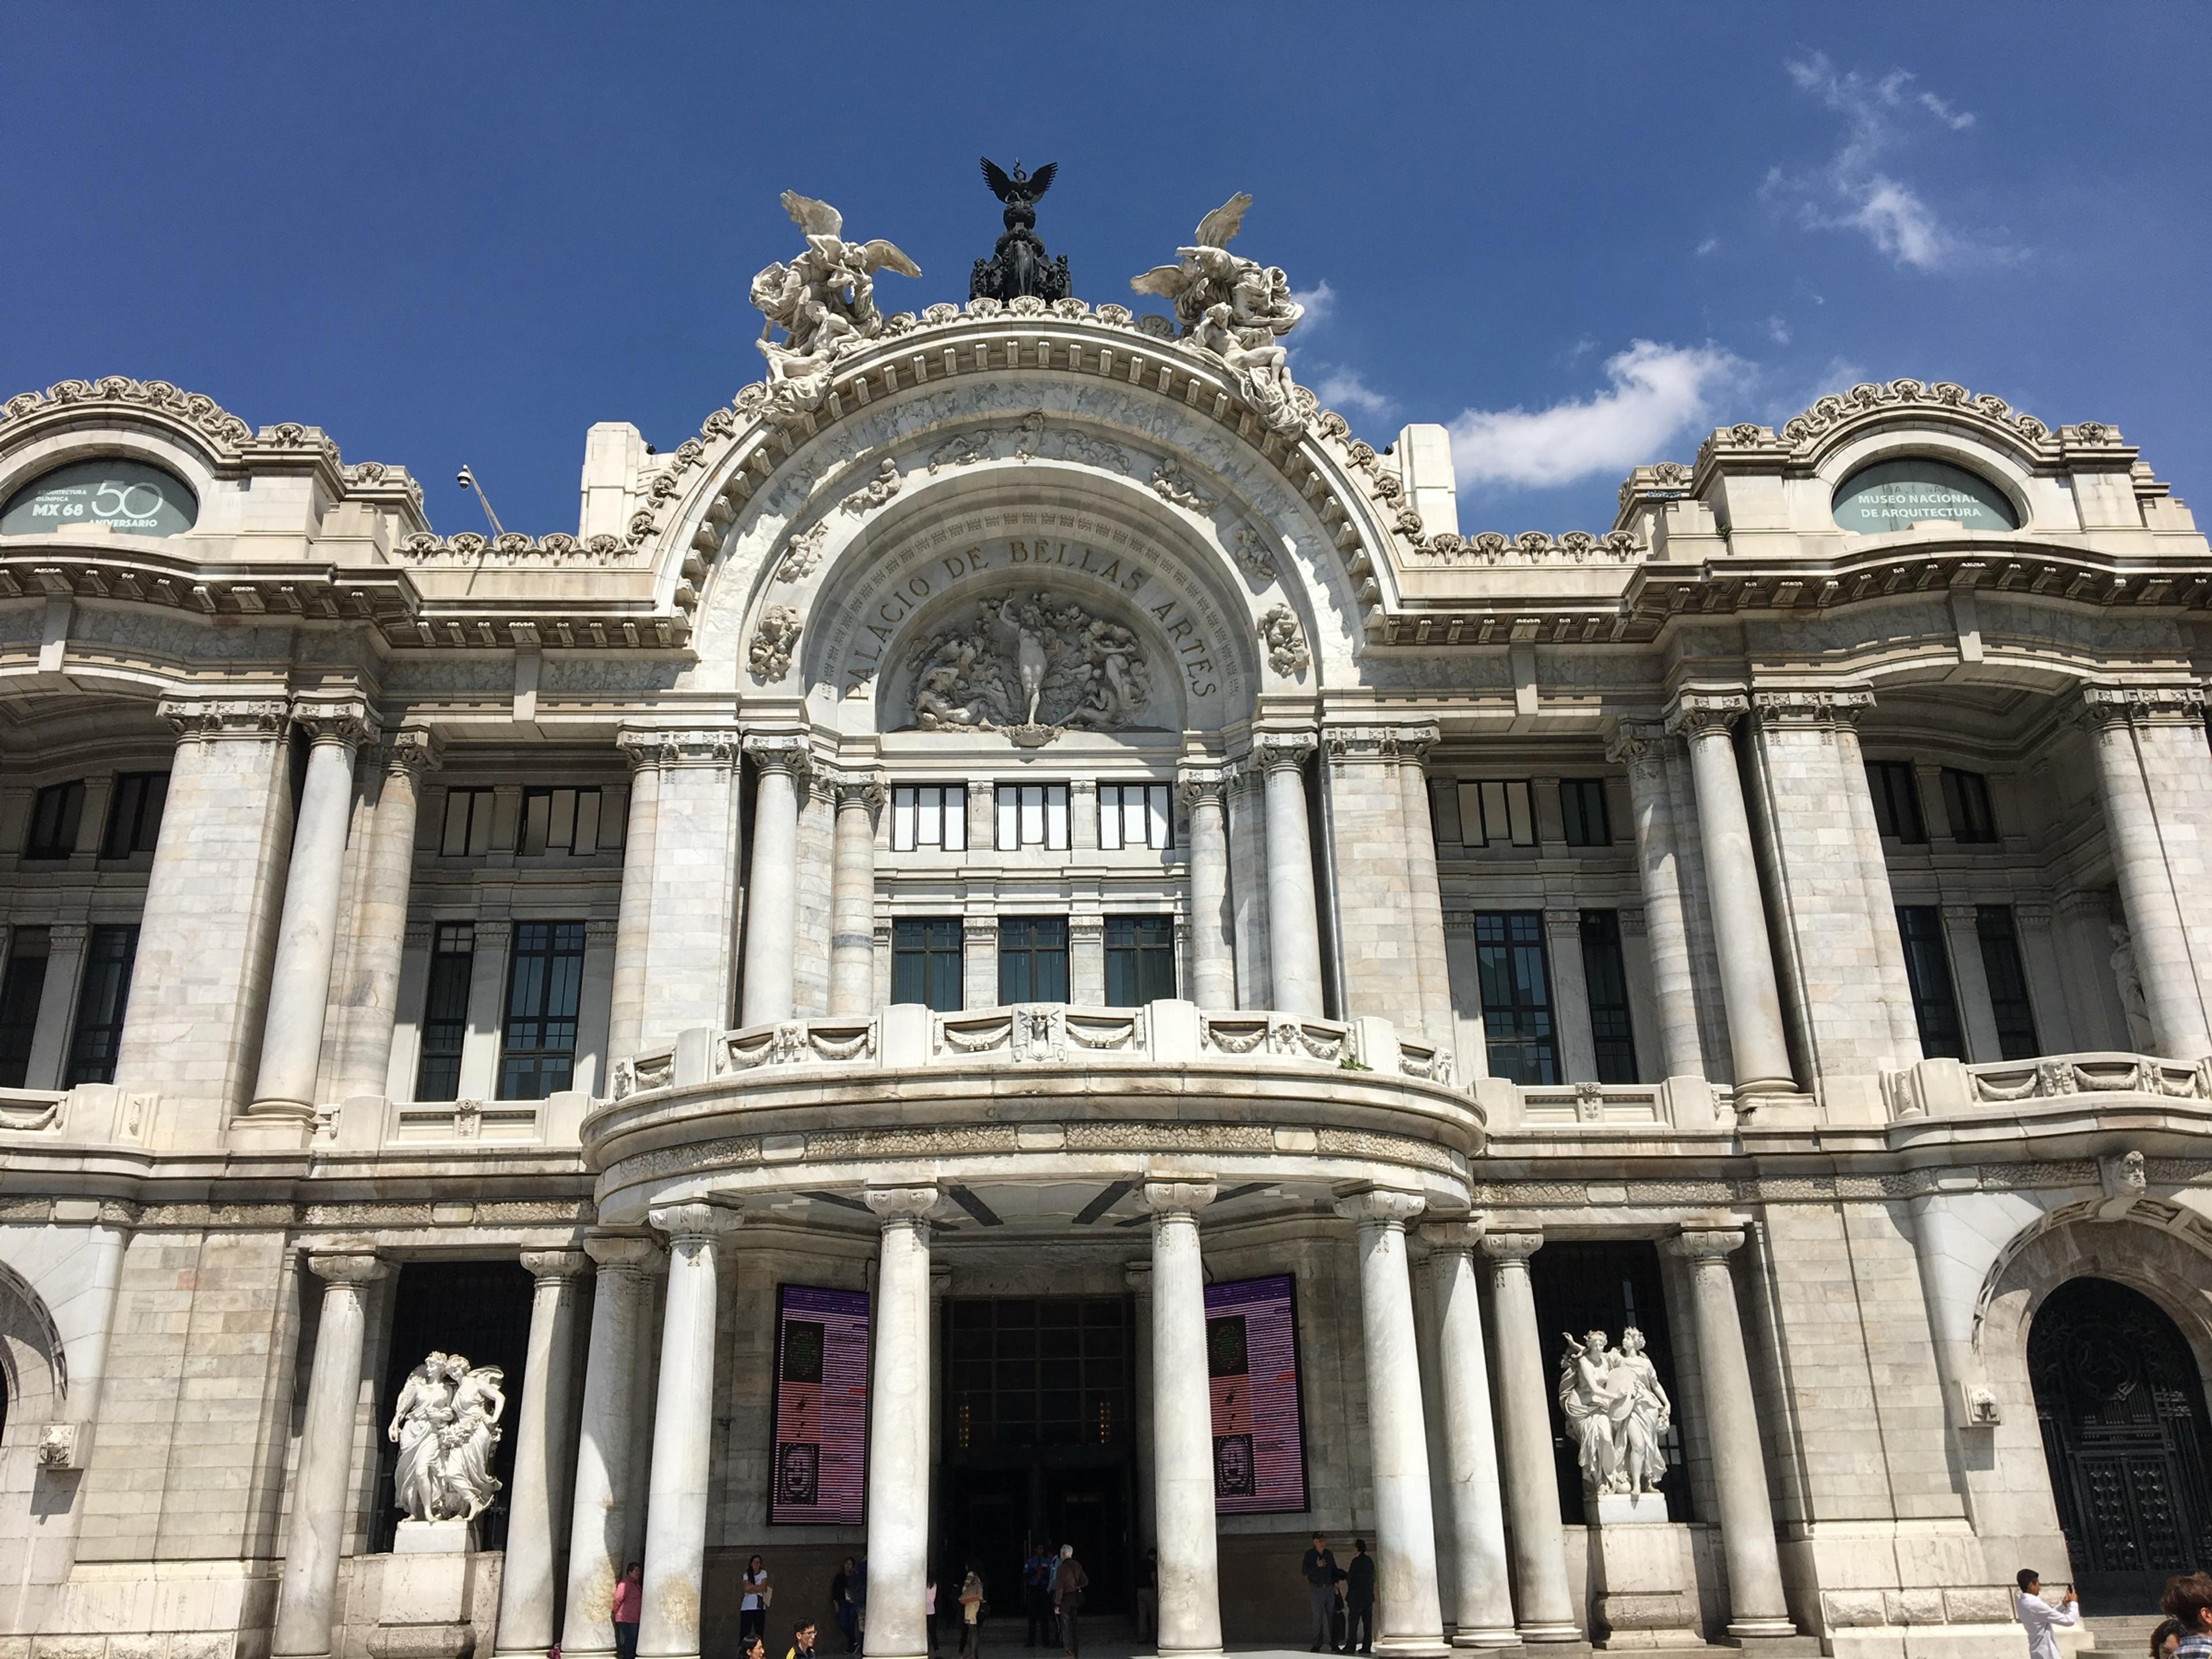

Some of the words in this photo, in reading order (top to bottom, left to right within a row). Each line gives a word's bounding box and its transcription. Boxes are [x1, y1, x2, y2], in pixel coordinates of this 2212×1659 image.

[91, 480, 164, 518] 50
[1858, 495, 1906, 503] MUSEO
[1910, 494, 1979, 503] NACIONAL
[32, 504, 60, 516] MX
[62, 503, 84, 516] 68
[1861, 509, 1879, 517] DE
[1882, 508, 1982, 518] ARQUITECTURA
[845, 578, 930, 701] PALACIO
[942, 547, 989, 579] DE
[1010, 540, 1144, 592] BELLAS
[1152, 601, 1217, 699] ARTES
